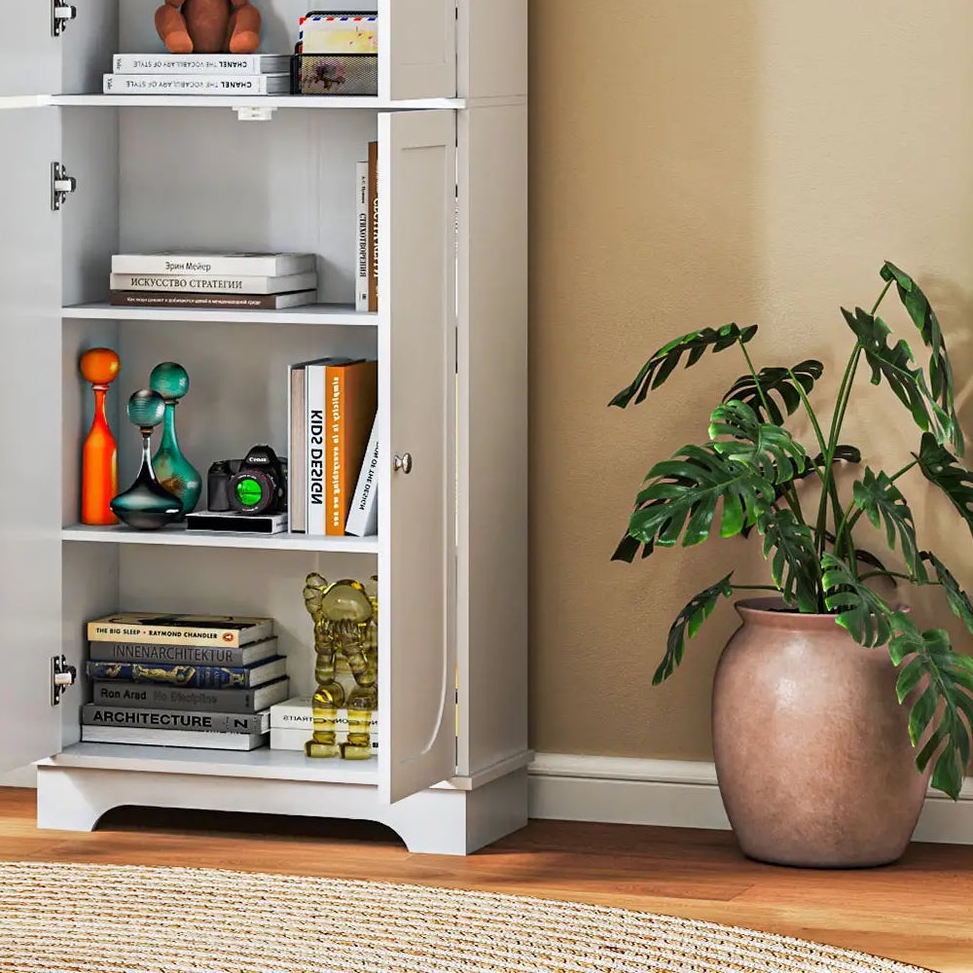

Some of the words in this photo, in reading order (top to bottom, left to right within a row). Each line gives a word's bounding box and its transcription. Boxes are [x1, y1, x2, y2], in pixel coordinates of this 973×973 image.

[163, 60, 205, 68] VOCABULARY
[206, 60, 217, 68] THE
[219, 60, 247, 68] CHANEL
[159, 81, 204, 89] VOCABULARY
[207, 81, 218, 89] THE
[220, 81, 252, 89] CHANEL
[359, 213, 367, 277] СТИХОТВОРЕНИЯ
[165, 261, 184, 271] Эрин
[185, 261, 211, 272] Мейер
[131, 277, 187, 288] ИСКУССТВО
[189, 279, 243, 289] СТРАТЕГИИ
[183, 631, 218, 639] CHANDLER
[113, 645, 234, 662] INNENARCHITEKTUR
[101, 688, 121, 698] Ron
[123, 689, 147, 700] Arad
[93, 710, 212, 728] ARCHITECTURE
